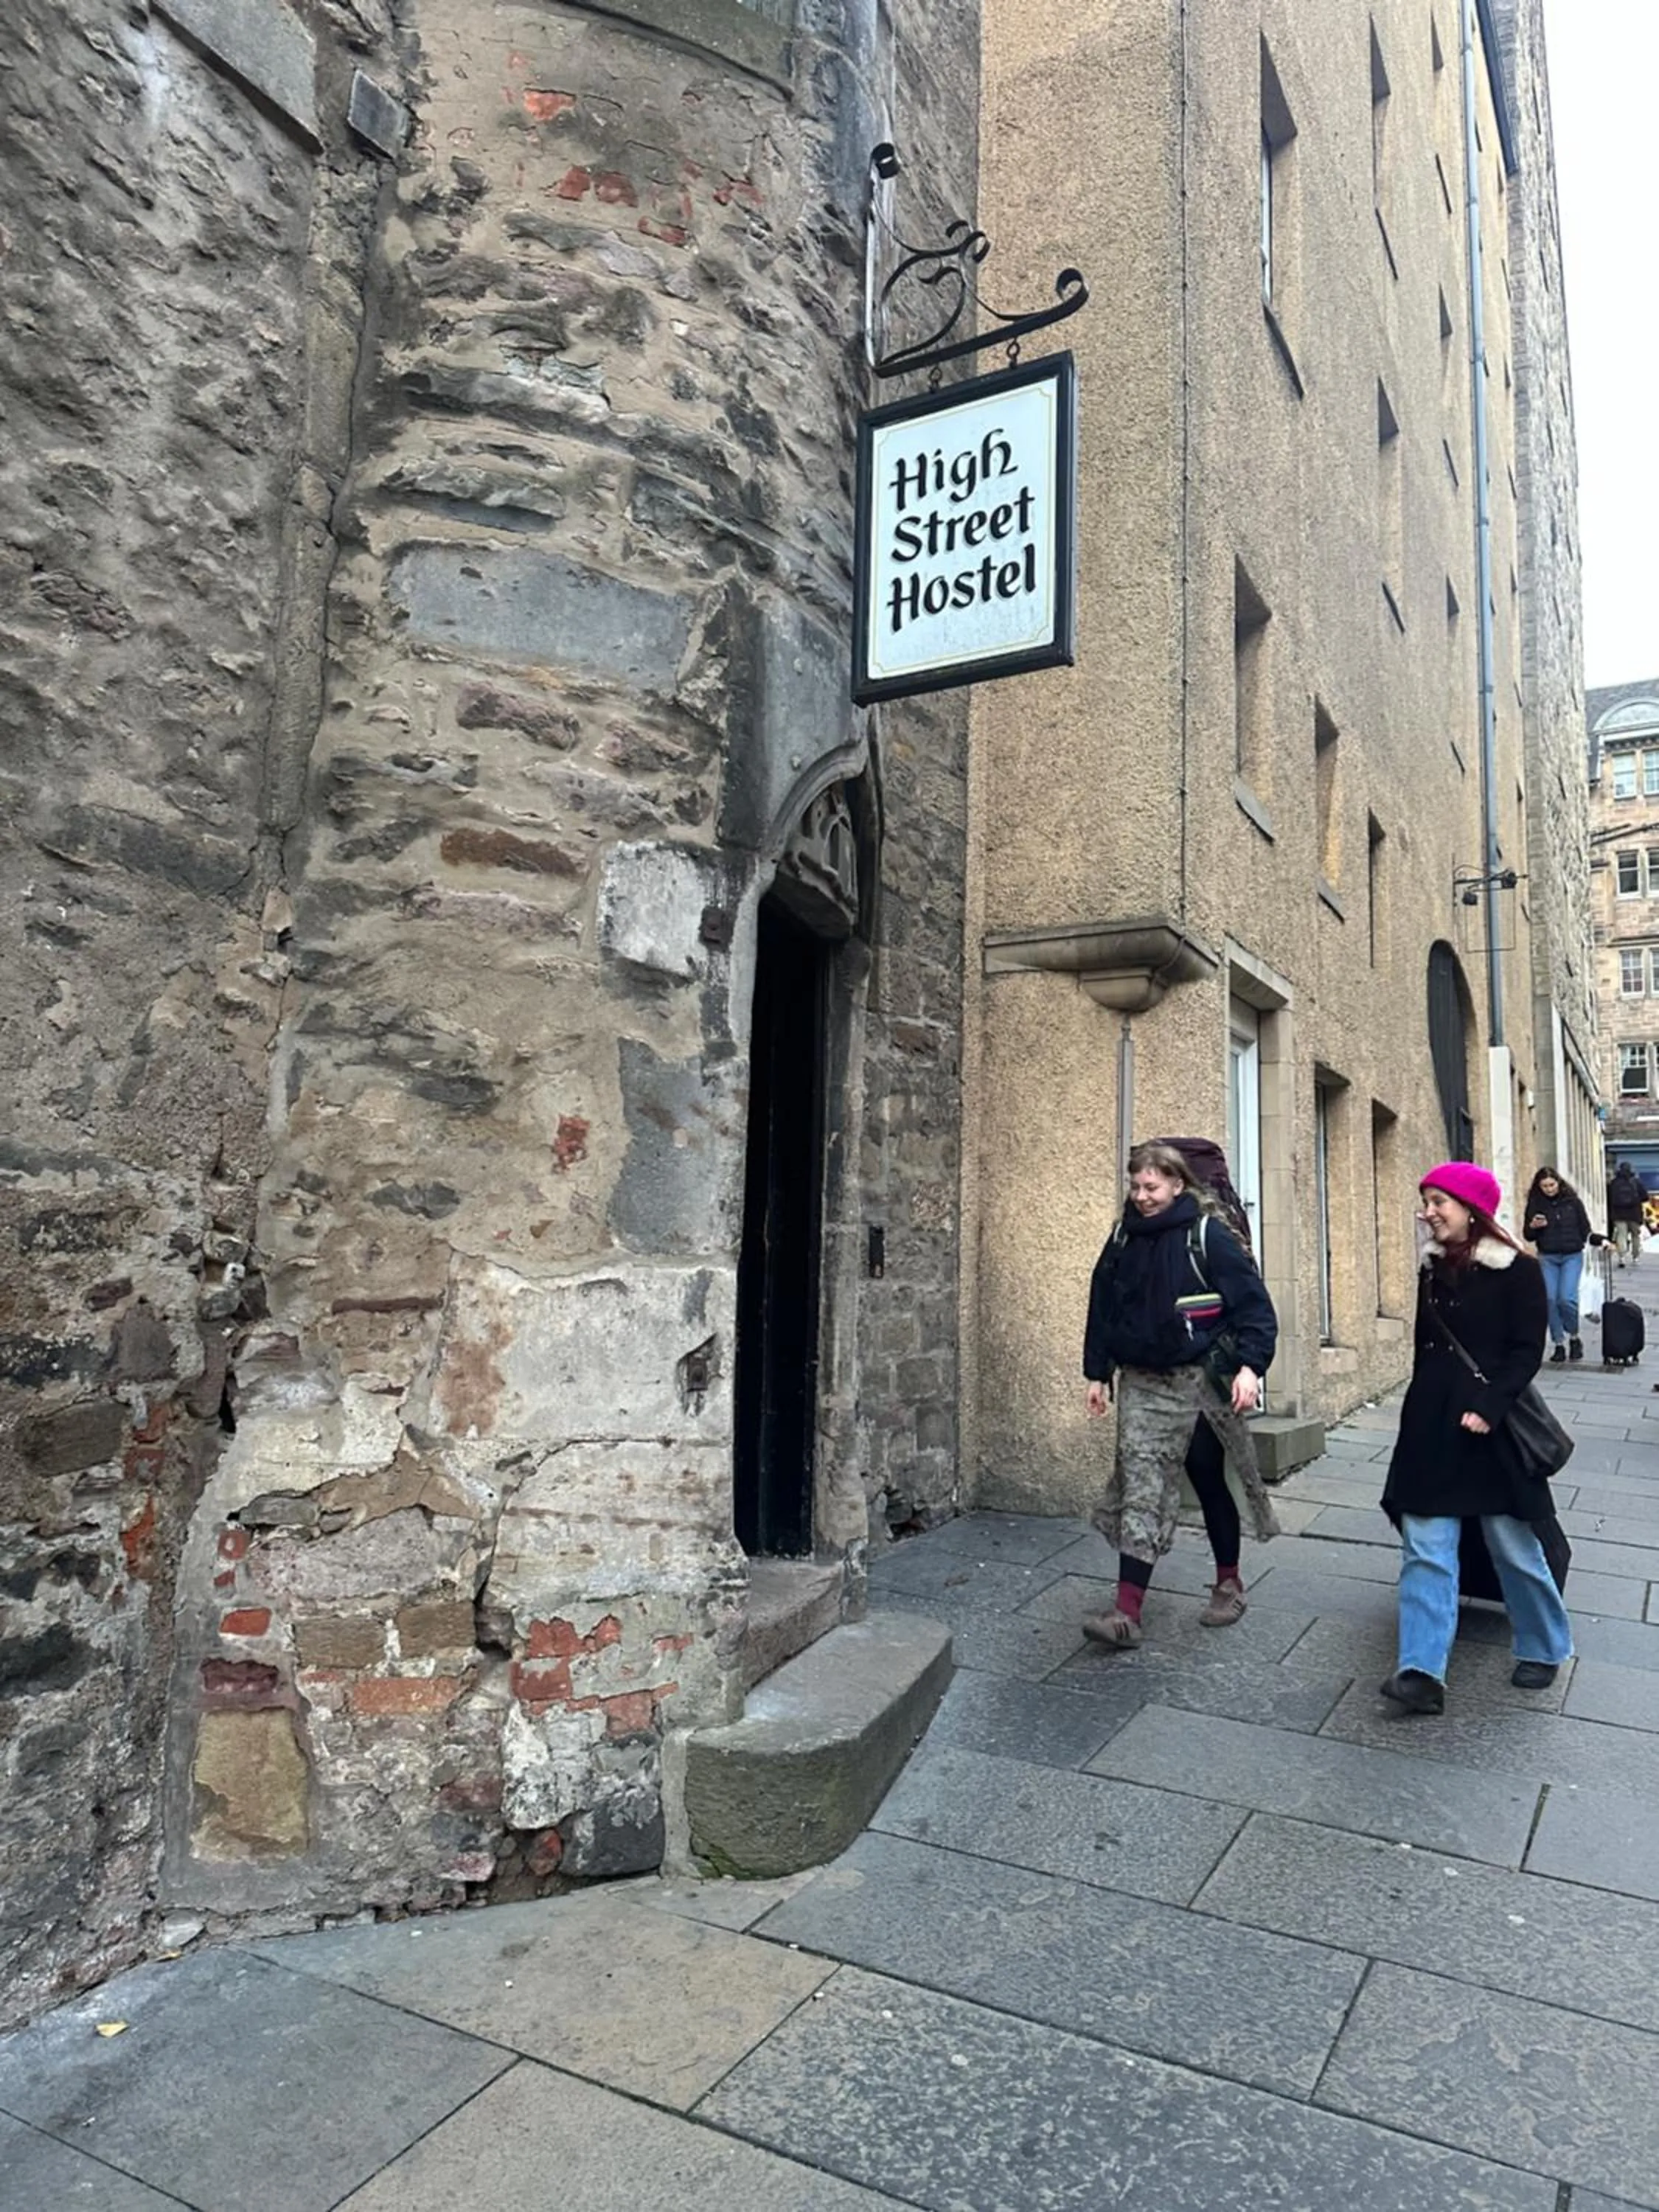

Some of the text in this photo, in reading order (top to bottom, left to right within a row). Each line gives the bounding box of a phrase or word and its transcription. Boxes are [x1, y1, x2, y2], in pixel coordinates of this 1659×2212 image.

[889, 428, 1018, 511] High
[891, 486, 1035, 562] Street
[887, 543, 1036, 632] Hostel
